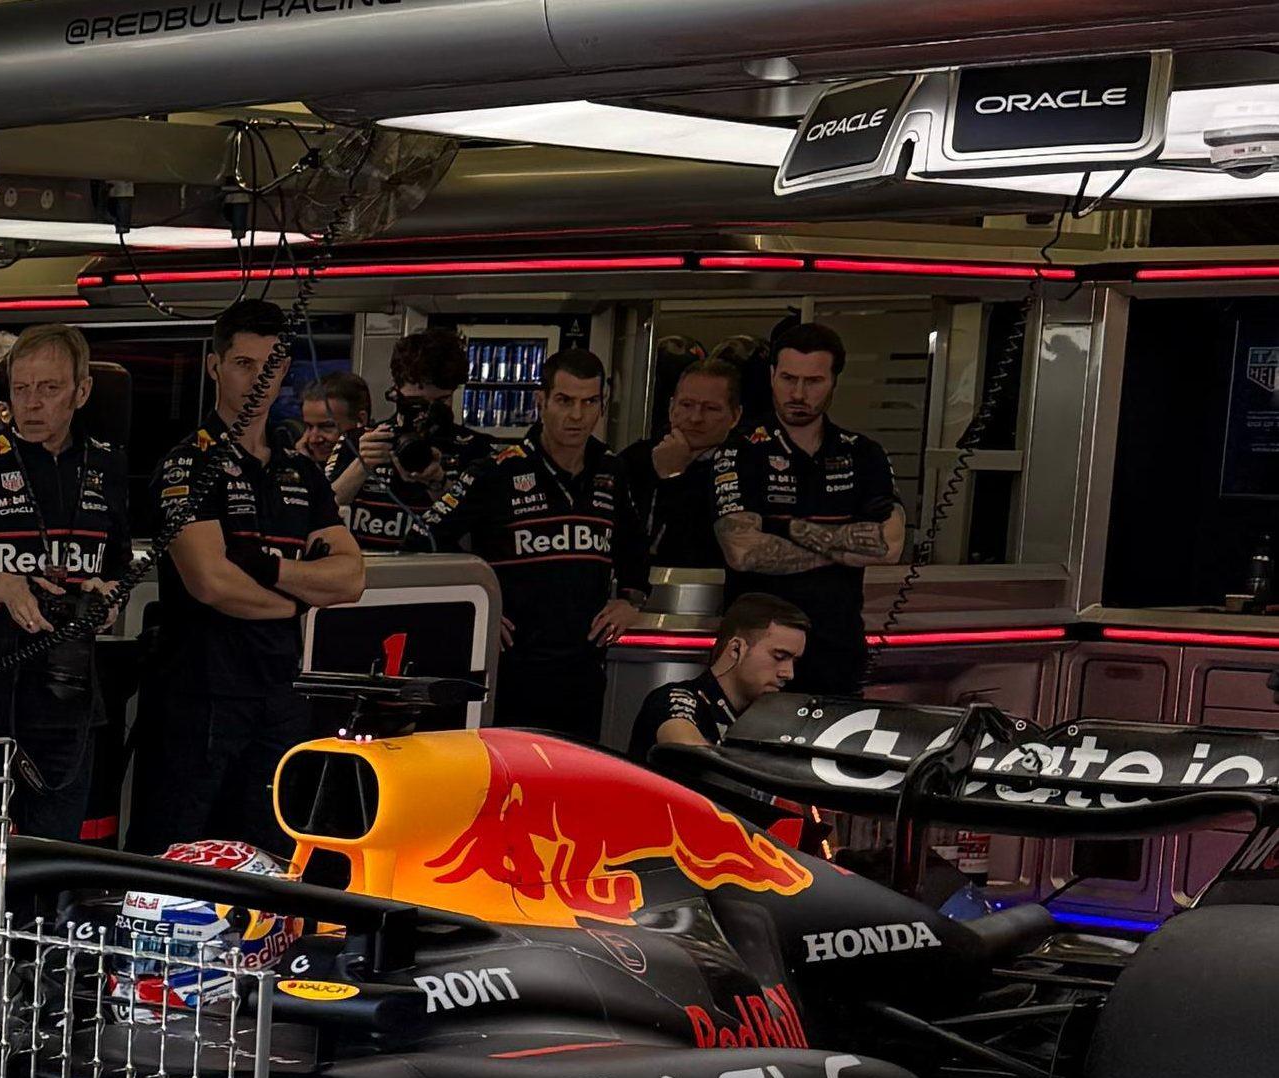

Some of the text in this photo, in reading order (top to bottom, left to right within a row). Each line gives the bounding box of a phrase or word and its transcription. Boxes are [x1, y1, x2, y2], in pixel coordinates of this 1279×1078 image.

[974, 86, 1129, 116] ORACLE
[805, 108, 889, 143] ORACLE
[353, 507, 404, 537] Red
[514, 523, 571, 556] Red
[382, 632, 408, 678] 1
[801, 921, 942, 964] HONDA
[415, 966, 522, 1015] ROKT
